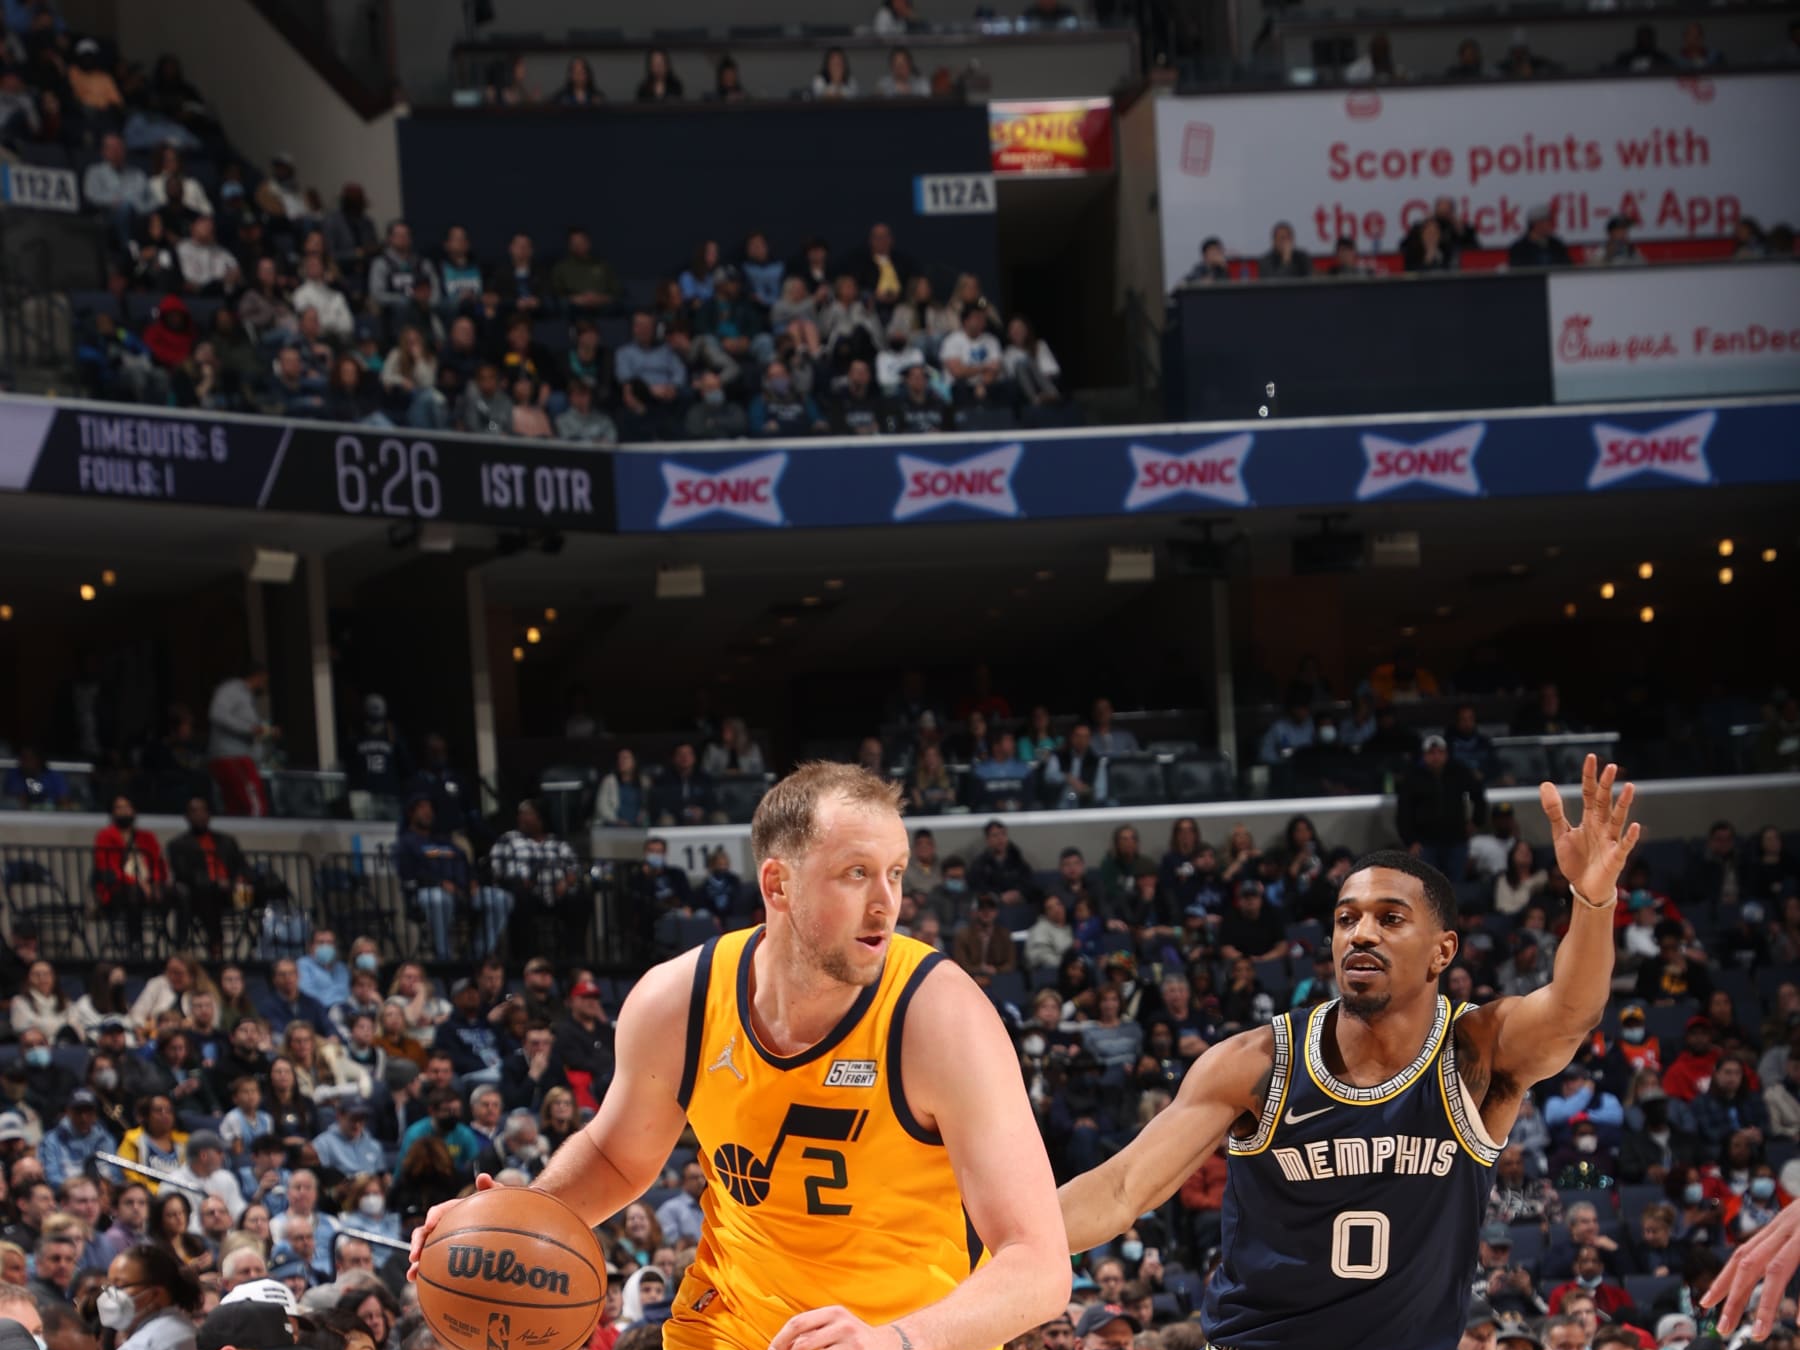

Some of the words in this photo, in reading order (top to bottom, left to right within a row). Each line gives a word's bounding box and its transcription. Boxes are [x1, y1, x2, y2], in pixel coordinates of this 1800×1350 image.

[1328, 141, 1455, 182] Score
[1467, 131, 1603, 187] points
[1615, 126, 1710, 168] with
[930, 178, 988, 208] 112A
[1313, 202, 1387, 243] the
[1655, 187, 1743, 238] App
[77, 415, 208, 461] TIMEOUTS:
[209, 424, 228, 464] 6
[1602, 434, 1699, 468] SONIC
[78, 454, 163, 497] FOULS:
[164, 463, 177, 496] 1
[334, 435, 442, 518] 6:26
[480, 463, 528, 509] 1ST
[533, 466, 593, 515] QTR
[906, 467, 1007, 500] SONIC
[1139, 457, 1238, 491] SONIC
[1370, 446, 1469, 480] SONIC
[671, 474, 771, 508] SONIC
[830, 1063, 845, 1083] 5
[845, 1074, 874, 1083] FIGHT
[1271, 1134, 1459, 1182] MEMPHIS
[801, 1146, 853, 1216] 2
[1330, 1210, 1391, 1280] 0
[447, 1245, 570, 1297] Wilson
